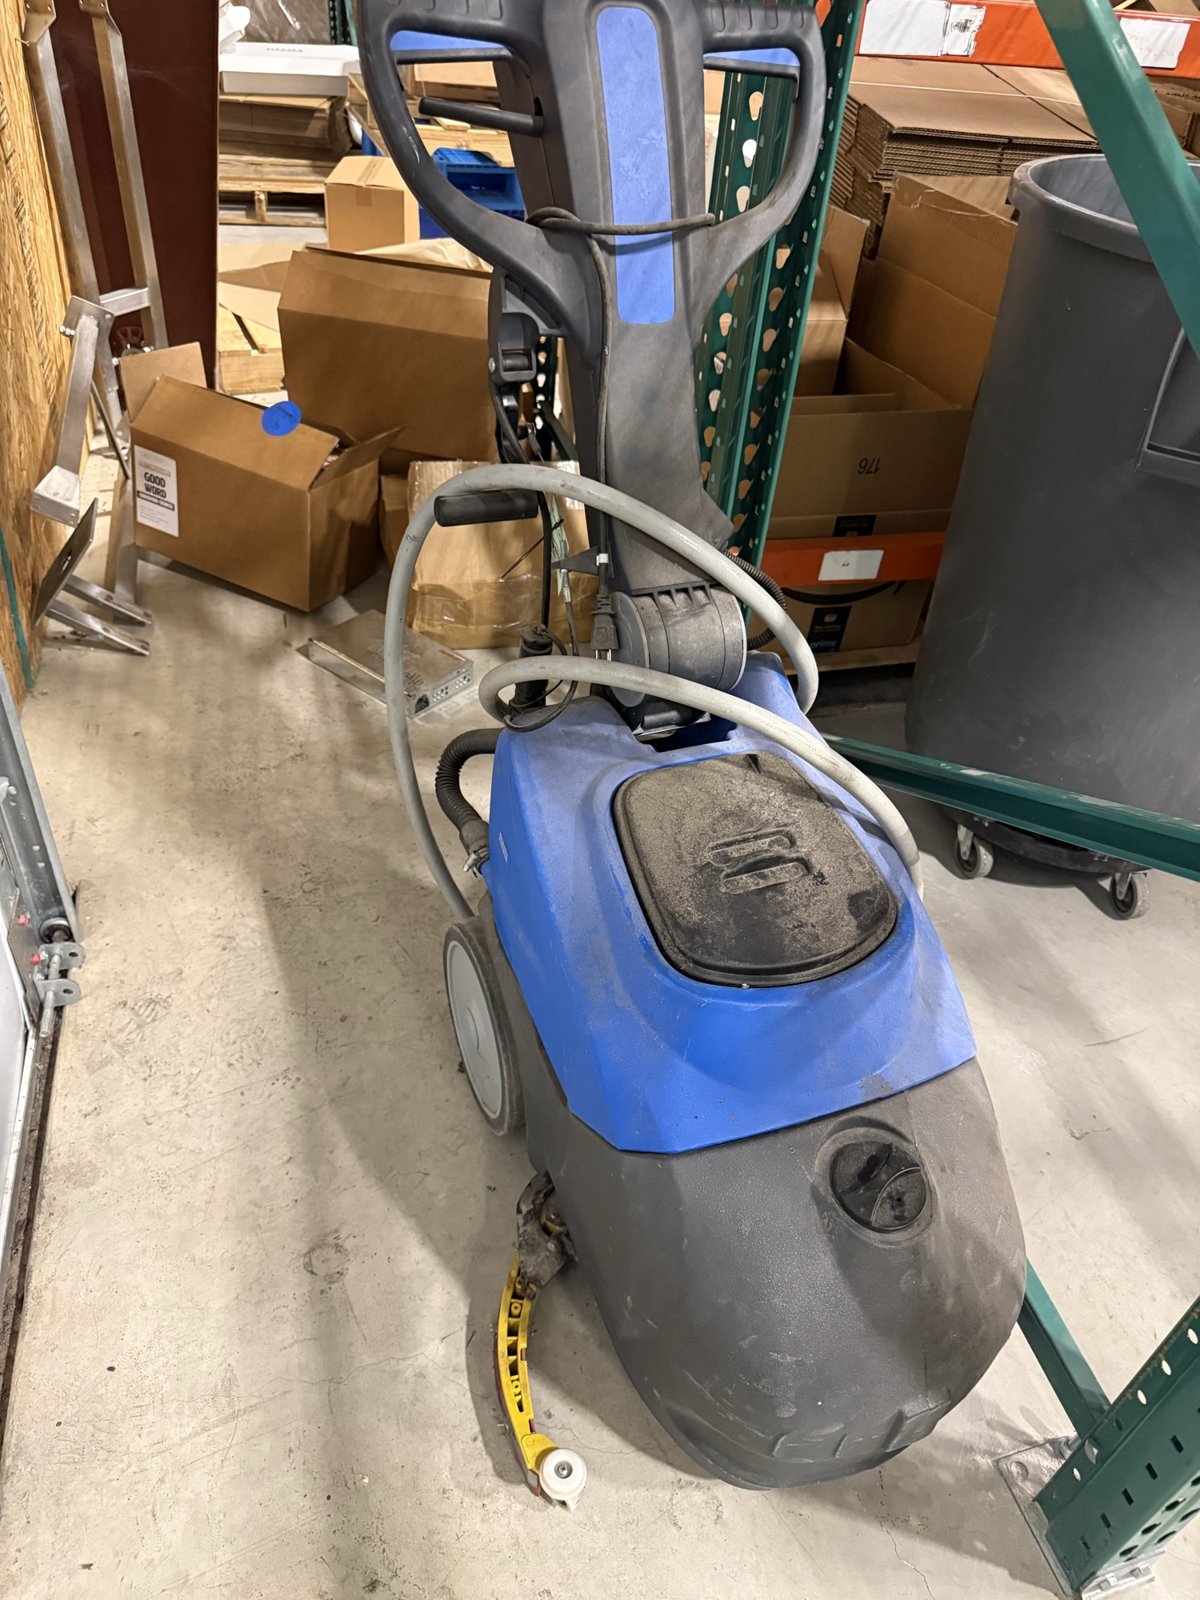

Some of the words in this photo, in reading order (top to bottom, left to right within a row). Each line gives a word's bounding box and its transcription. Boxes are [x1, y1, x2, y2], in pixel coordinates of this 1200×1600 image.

[857, 458, 880, 475] 176
[144, 472, 166, 488] GOOD
[144, 482, 167, 499] WORD
